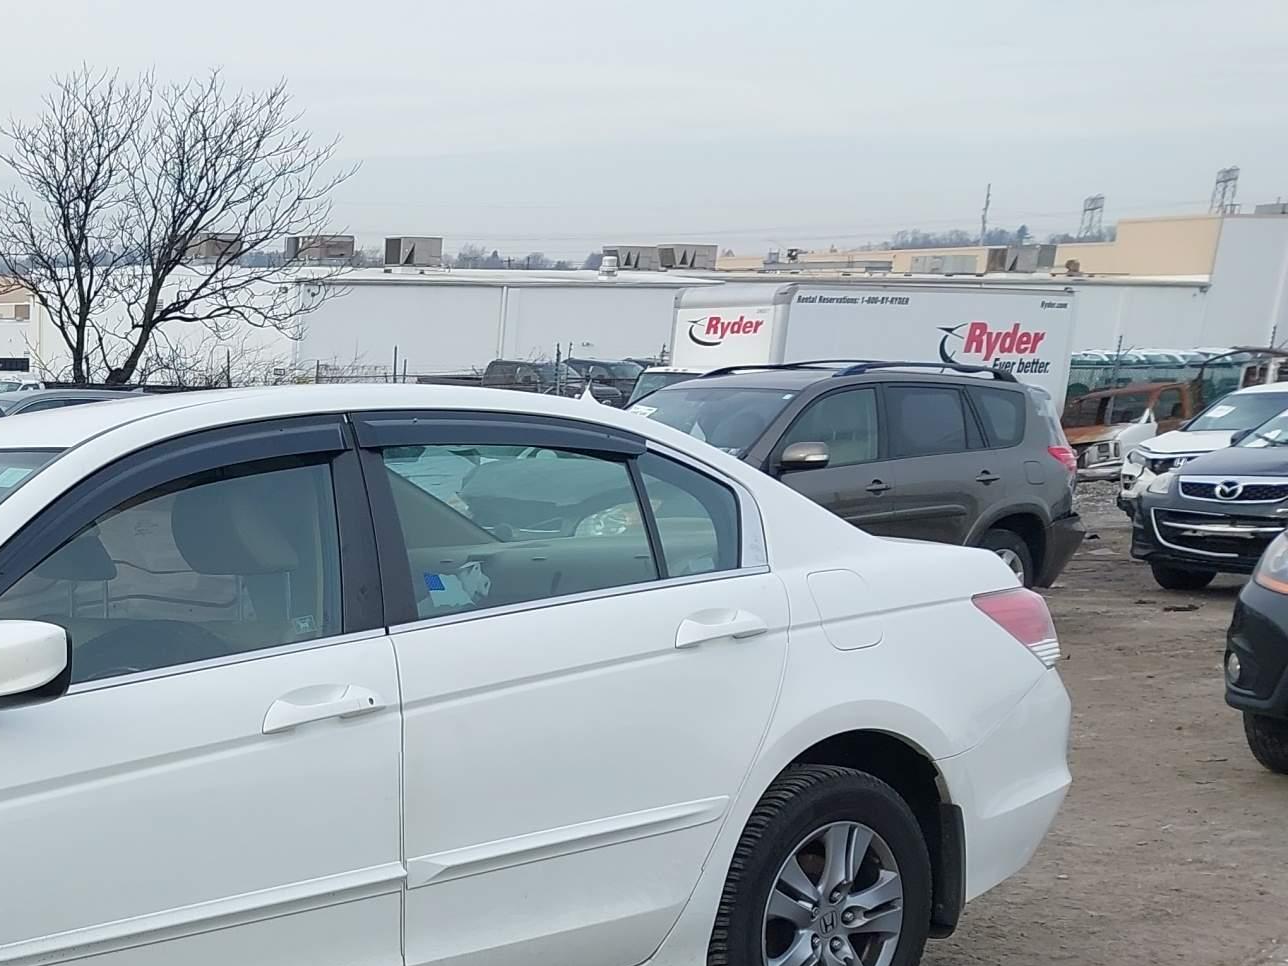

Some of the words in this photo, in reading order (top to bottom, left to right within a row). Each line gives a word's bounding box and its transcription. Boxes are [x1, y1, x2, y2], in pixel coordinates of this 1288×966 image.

[797, 295, 817, 304] Rental
[818, 295, 859, 304] Reservations:
[705, 316, 764, 339] Ryder
[963, 322, 1046, 361] Ryder
[1016, 358, 1050, 373] better.
